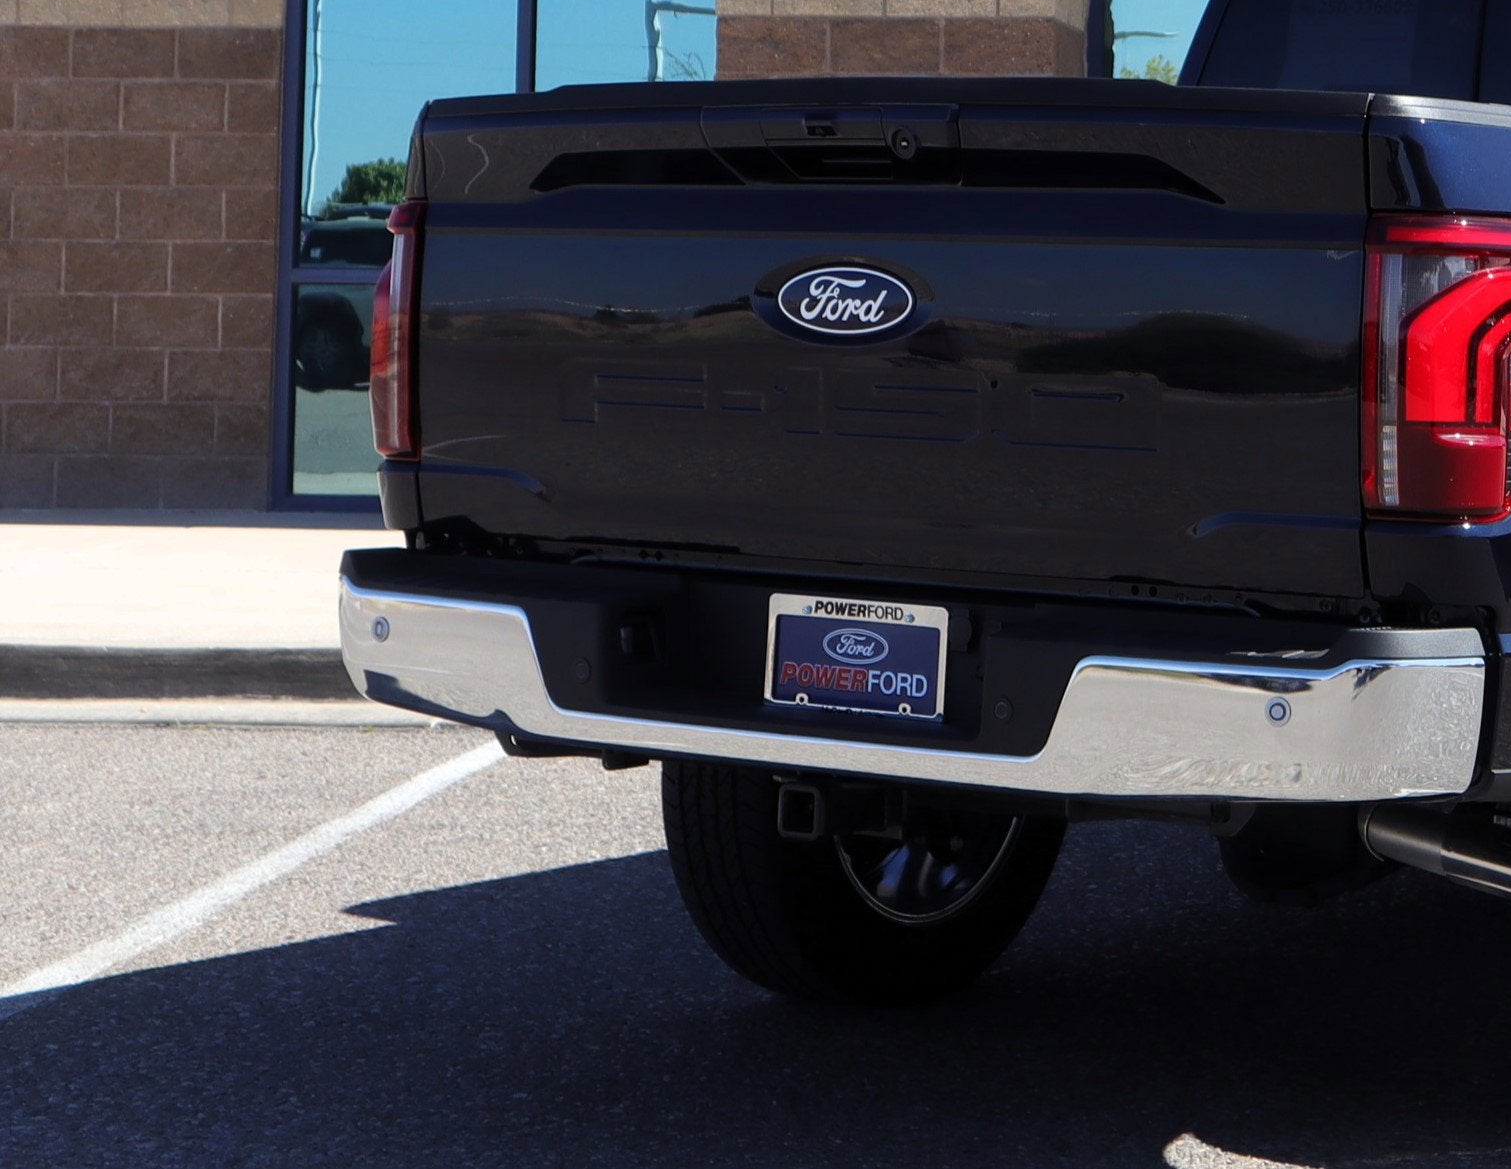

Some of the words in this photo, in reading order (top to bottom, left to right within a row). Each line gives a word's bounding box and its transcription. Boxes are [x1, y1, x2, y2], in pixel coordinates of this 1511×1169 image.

[800, 275, 888, 323] Ford
[813, 600, 905, 621] POWERFORD
[835, 634, 876, 657] Ford
[780, 661, 928, 698] POWERFORD
